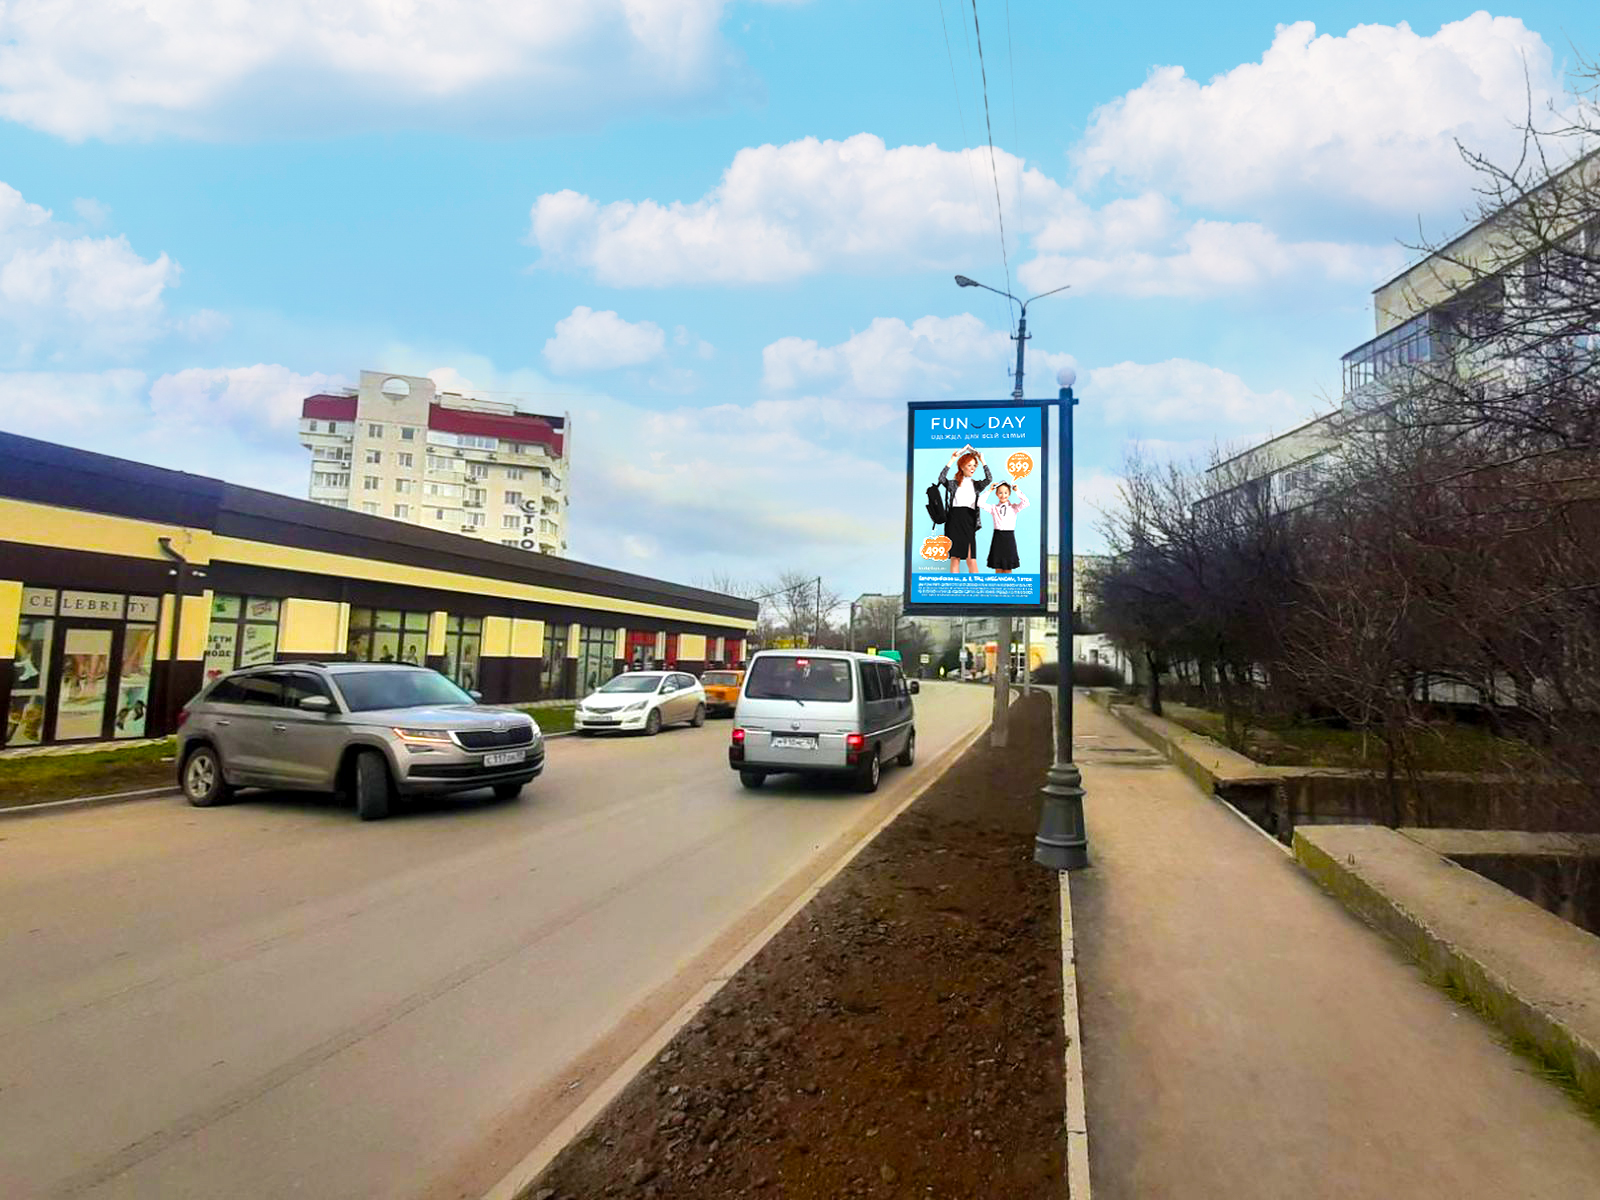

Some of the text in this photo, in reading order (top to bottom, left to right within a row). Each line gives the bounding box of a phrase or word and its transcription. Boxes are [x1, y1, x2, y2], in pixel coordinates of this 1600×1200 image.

[931, 416, 1026, 430] FUN DAY
[30, 595, 149, 613] CELEBRITY
